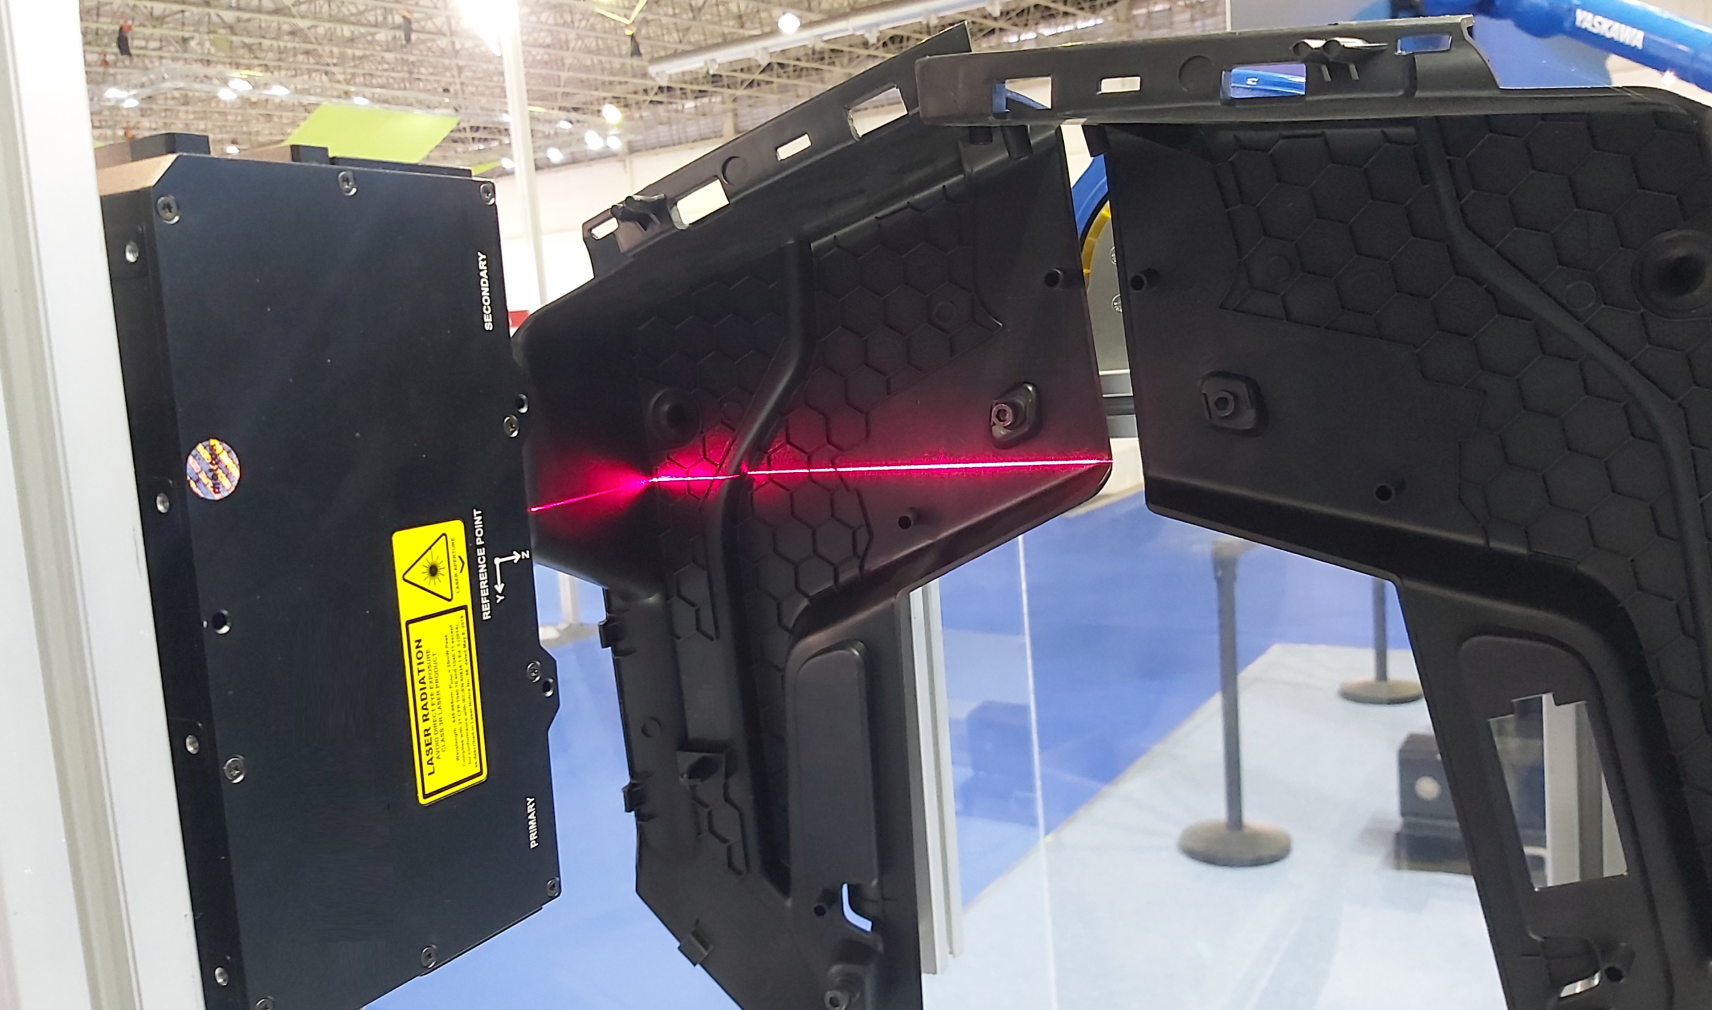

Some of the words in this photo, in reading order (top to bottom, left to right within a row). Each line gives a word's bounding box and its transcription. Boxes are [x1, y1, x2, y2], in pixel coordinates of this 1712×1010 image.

[1575, 8, 1645, 50] YASKAWA
[477, 251, 493, 331] SECONDARY
[473, 508, 485, 546] POINT
[476, 547, 492, 620] REFERENCE
[496, 594, 505, 604] Y
[415, 638, 430, 723] RADIATION
[426, 649, 434, 690] EXPOSURE
[424, 726, 435, 776] LASER
[526, 797, 539, 849] PRIMARY
